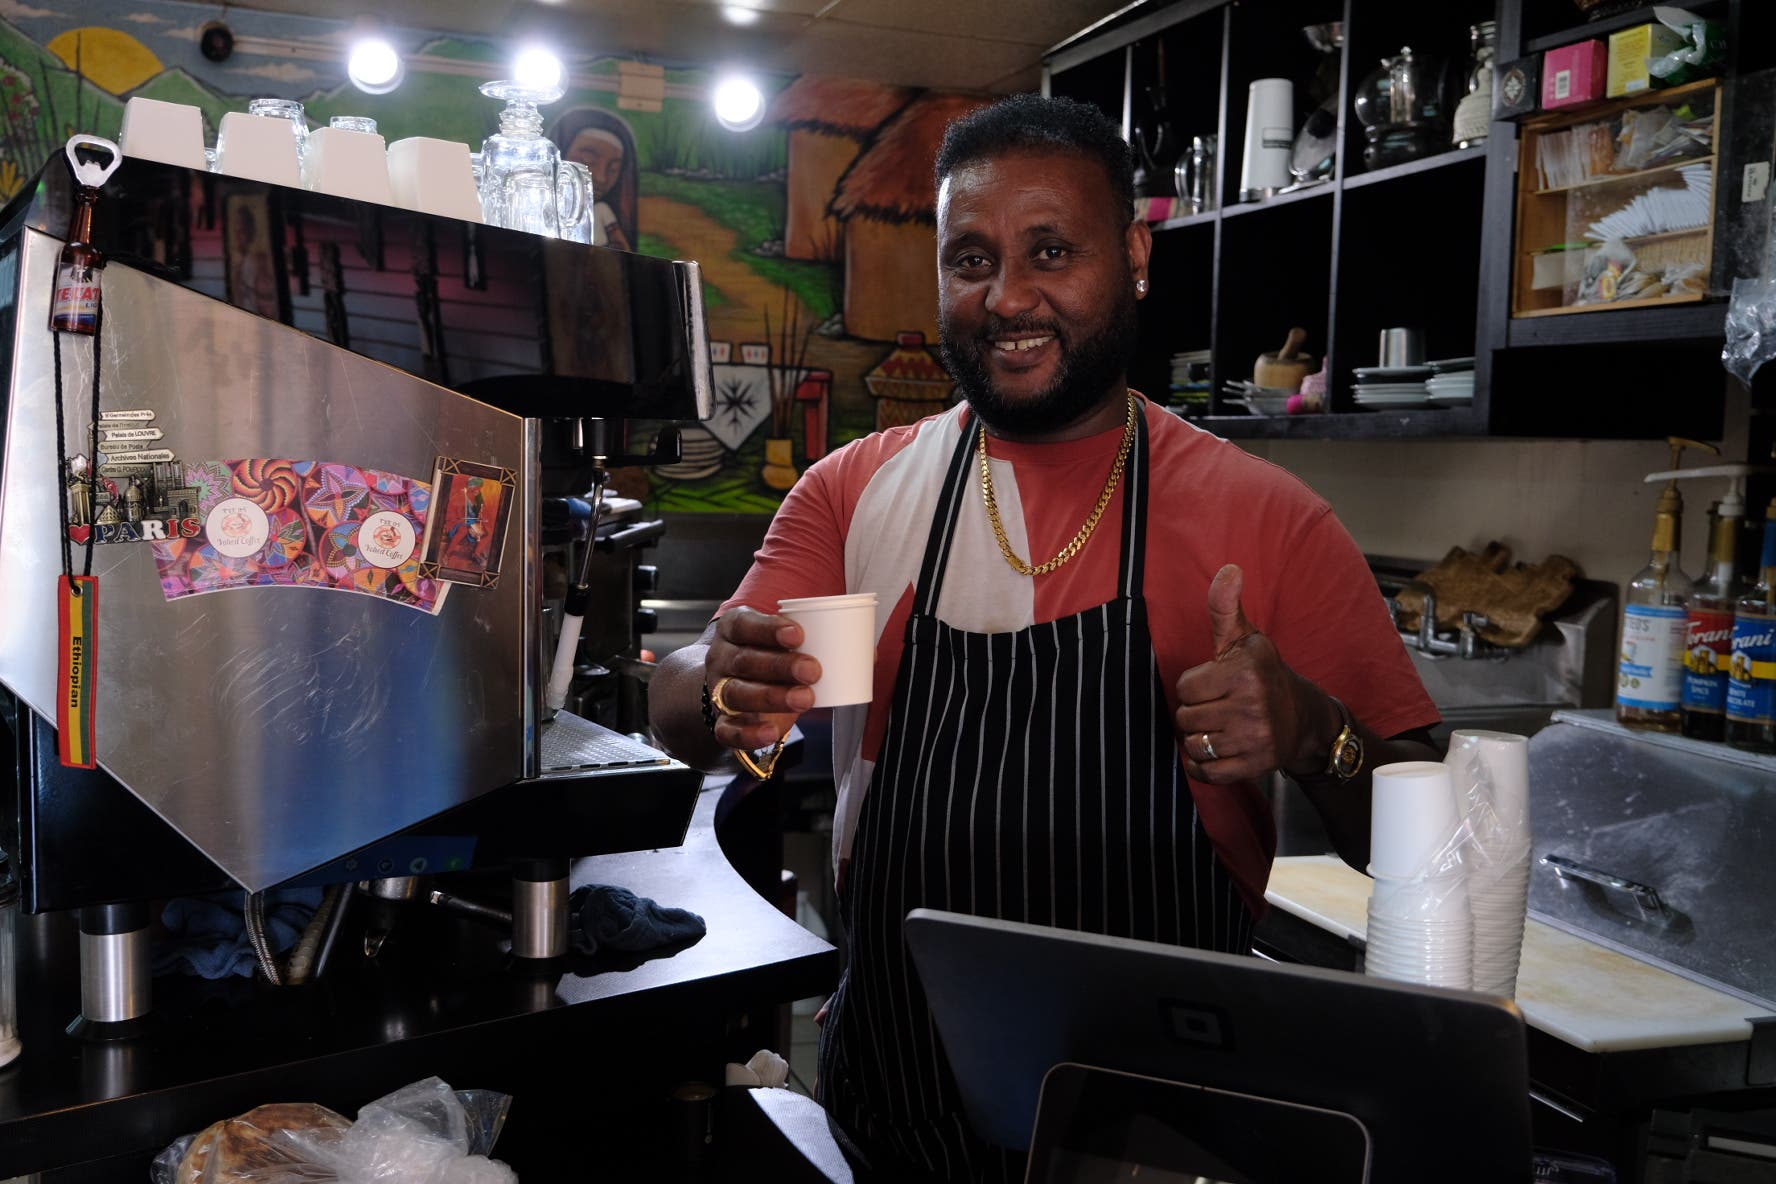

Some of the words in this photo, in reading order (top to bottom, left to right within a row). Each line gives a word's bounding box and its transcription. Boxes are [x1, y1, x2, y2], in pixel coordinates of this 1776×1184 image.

[138, 452, 170, 461] Nationales
[95, 518, 200, 544] PARIS
[70, 636, 82, 708] Ethiopian
